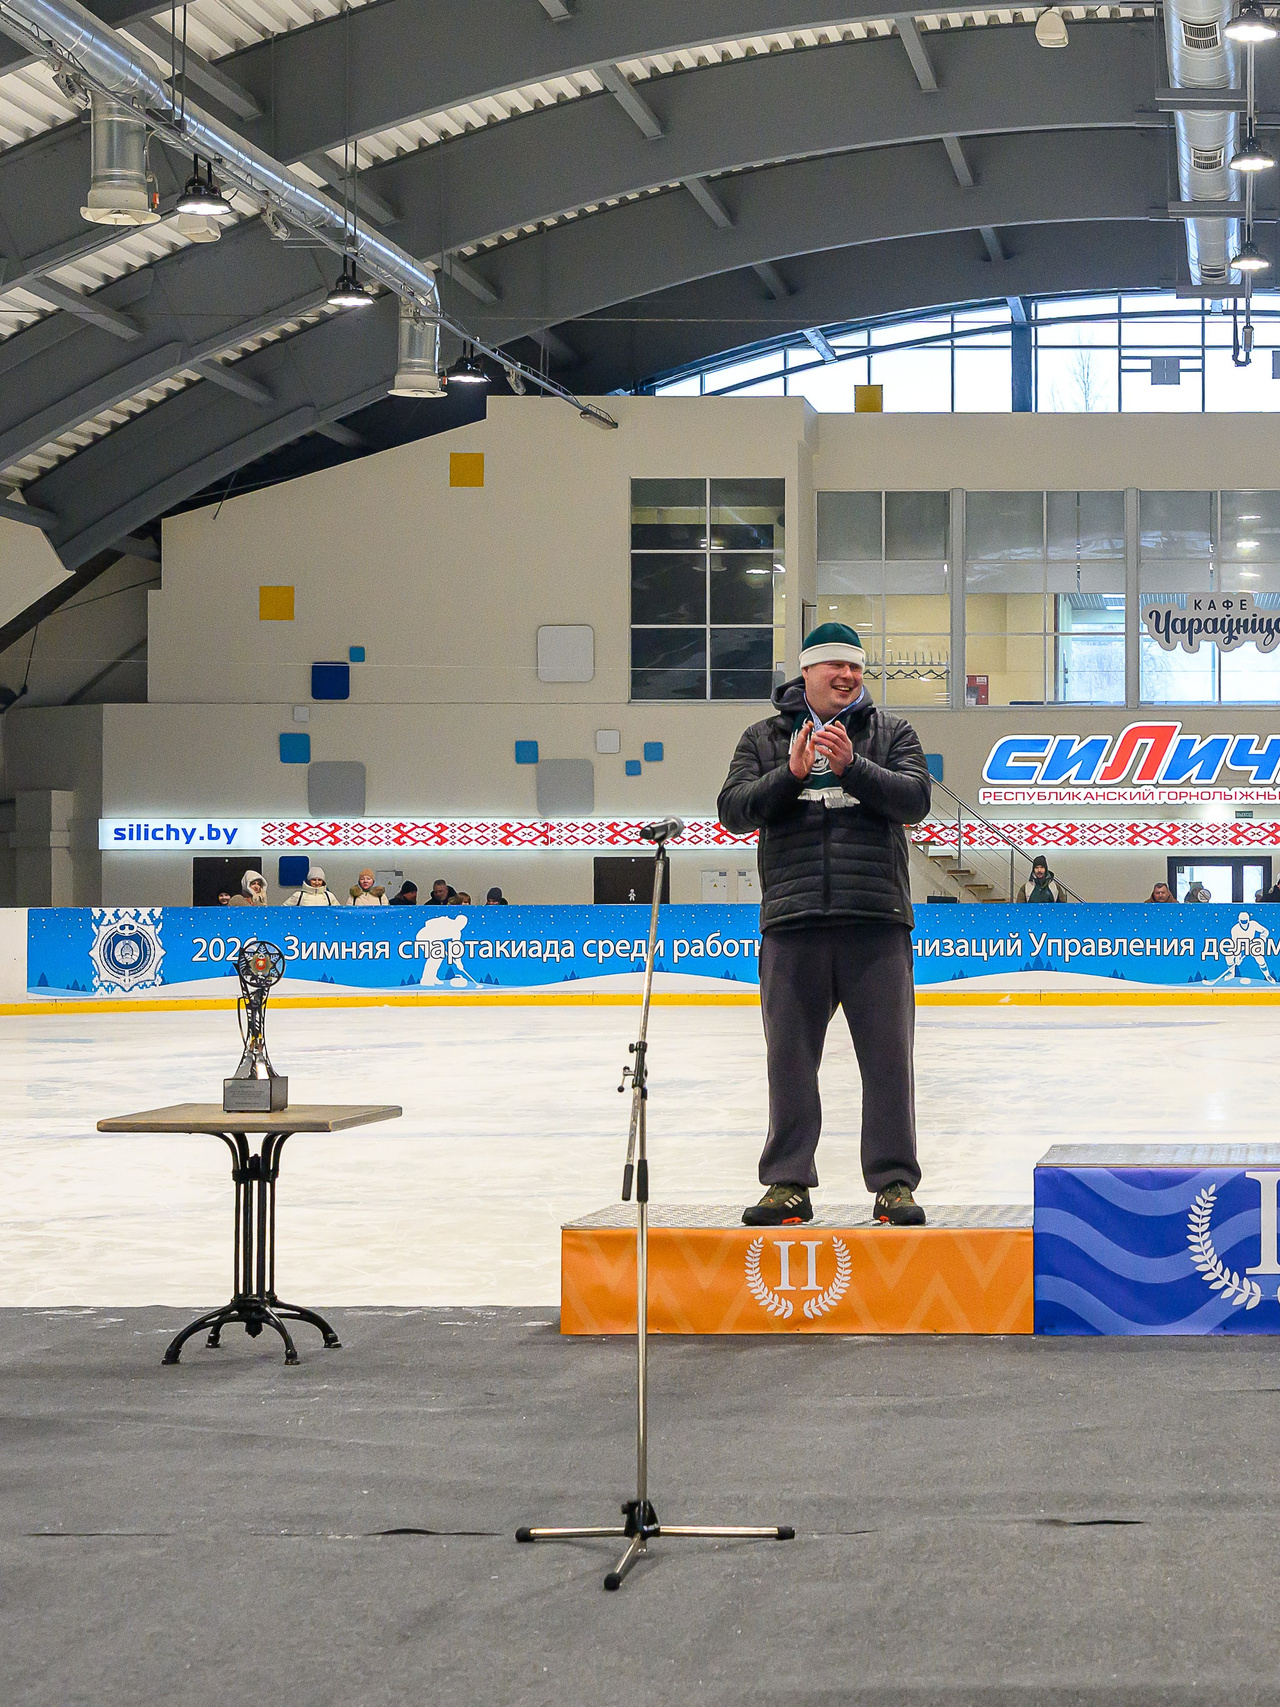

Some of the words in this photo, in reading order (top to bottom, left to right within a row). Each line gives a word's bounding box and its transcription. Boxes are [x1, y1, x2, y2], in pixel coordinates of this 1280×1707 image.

[1194, 599, 1247, 611] КАФЕ
[982, 789, 1154, 801] РЕСПУБЛИКАНСКИЙ
[113, 823, 238, 845] silichy.by
[284, 936, 390, 960] Зимняя
[398, 940, 575, 965] спартакиада
[582, 939, 664, 963] среди
[673, 932, 760, 963] работ
[912, 932, 1022, 962] низаций
[1028, 932, 1194, 963] Управления
[773, 1241, 823, 1290] II
